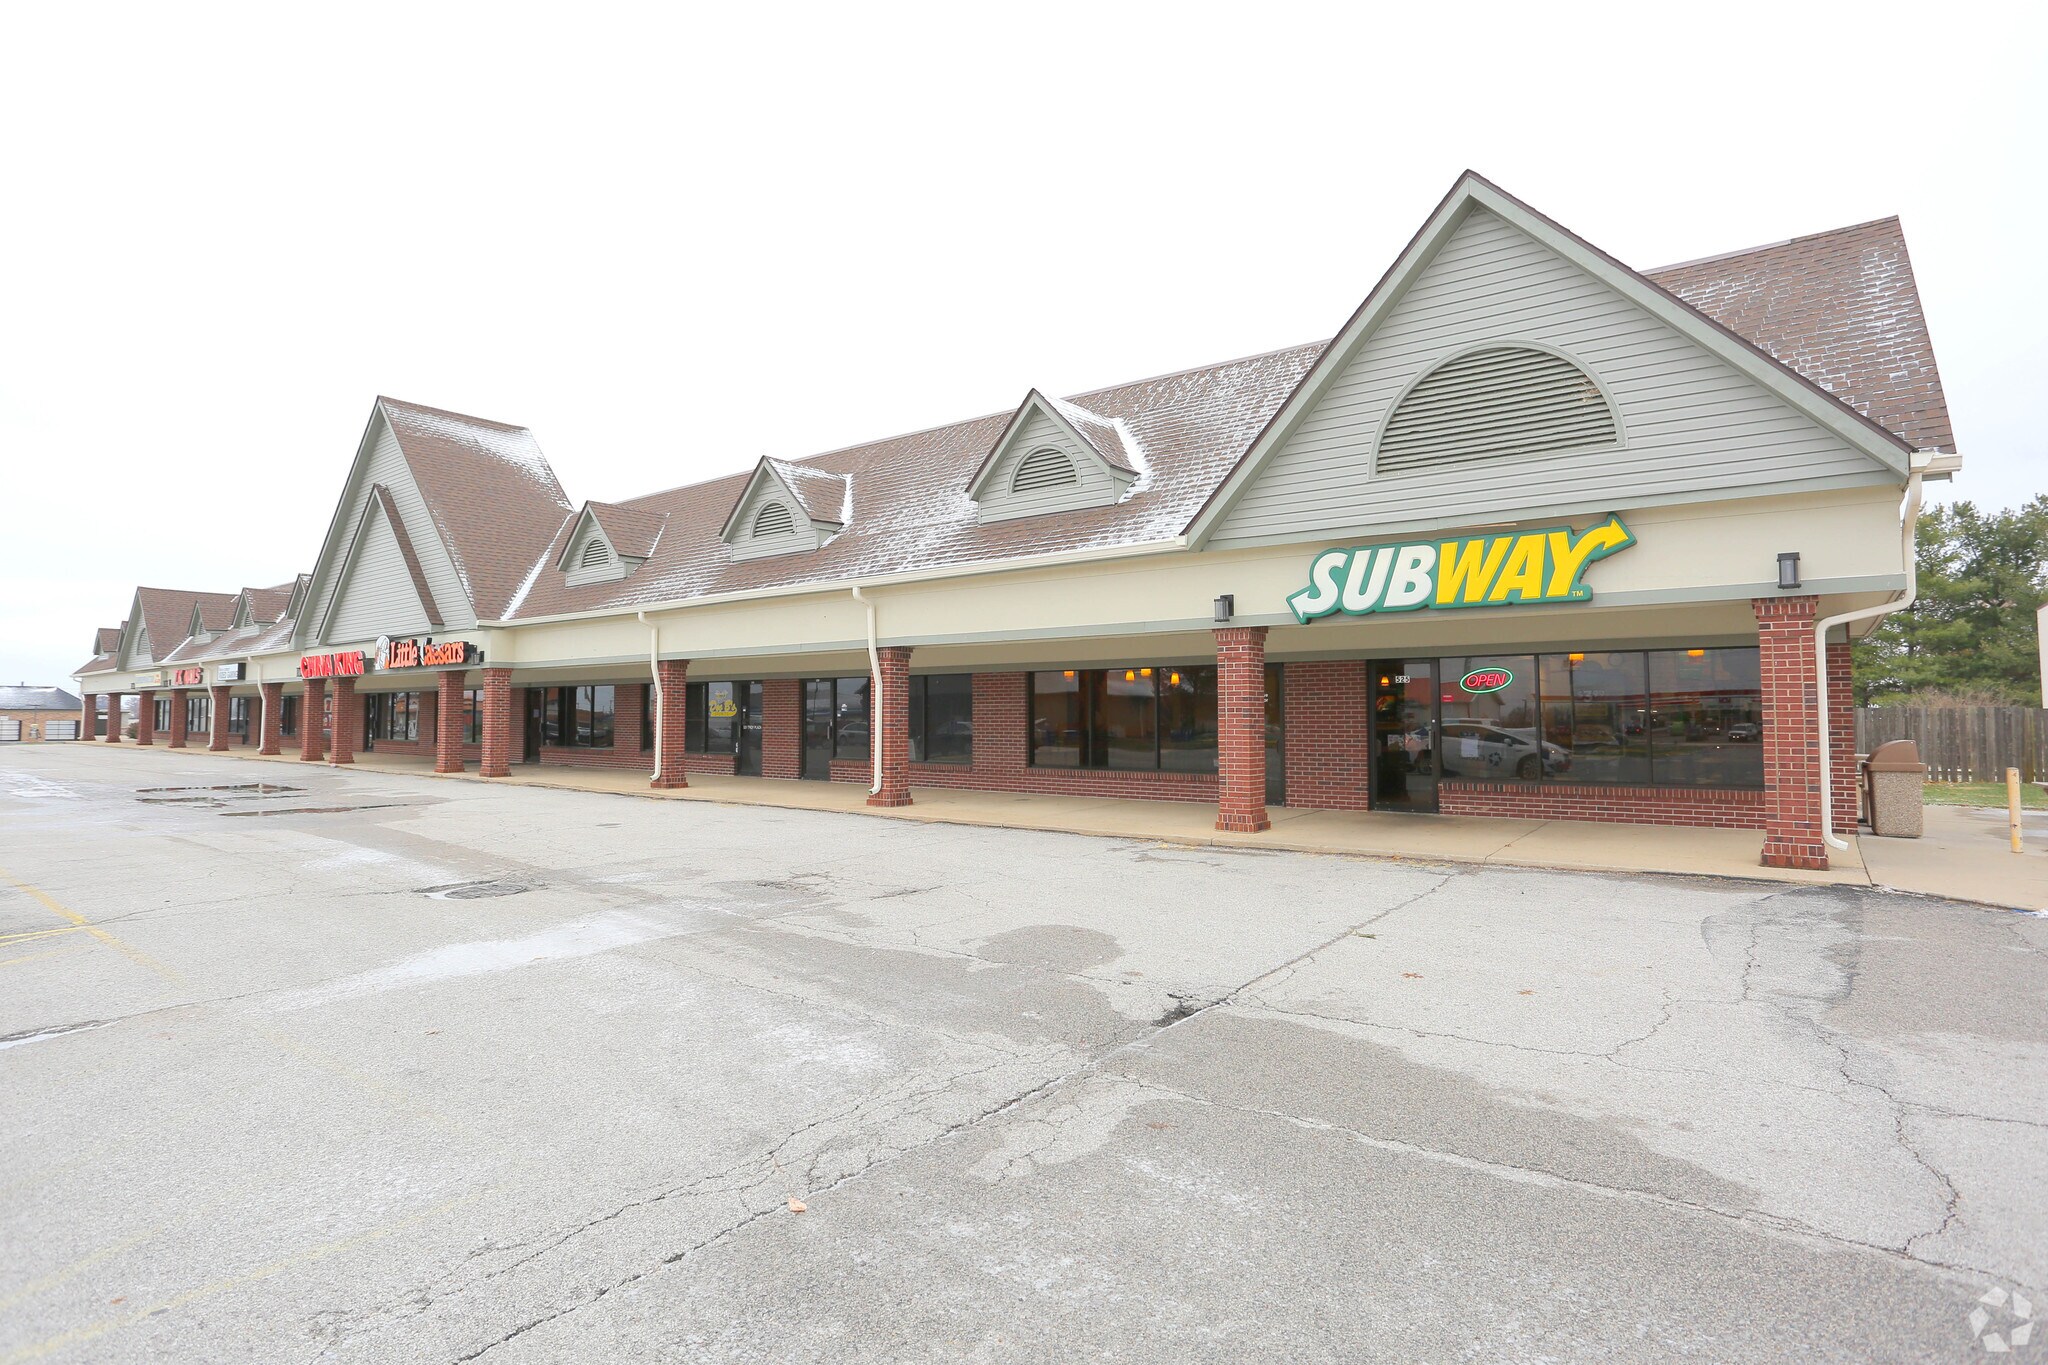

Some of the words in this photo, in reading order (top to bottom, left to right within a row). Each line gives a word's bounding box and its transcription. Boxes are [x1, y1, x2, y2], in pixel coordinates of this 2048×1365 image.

[1290, 518, 1630, 619] SUBWAY
[300, 655, 332, 679] CHINA
[333, 651, 364, 676] KING
[390, 639, 417, 668] Little
[420, 637, 465, 666] Caesars
[1395, 676, 1411, 684] 525
[1466, 674, 1508, 688] OPEN
